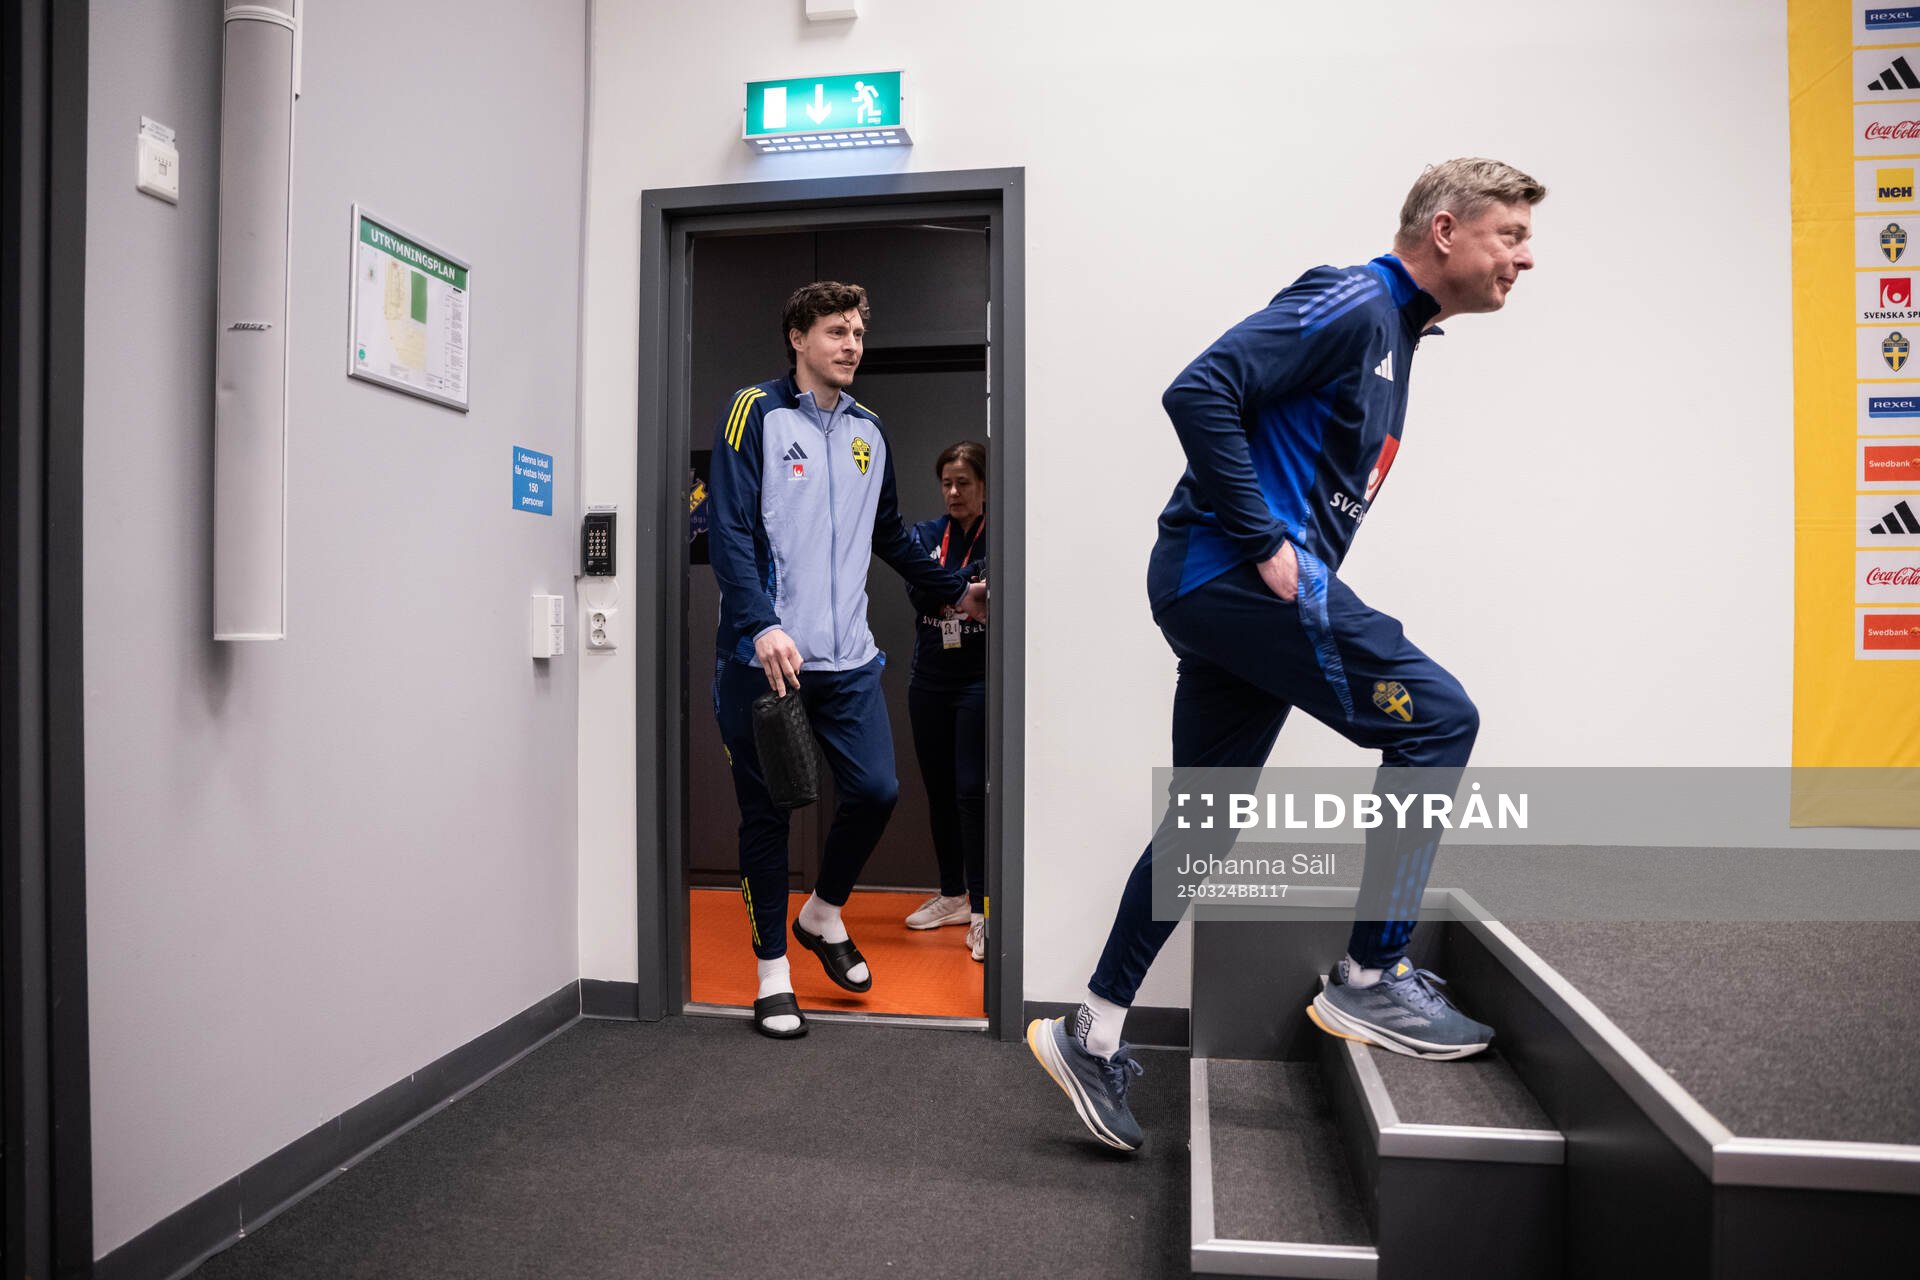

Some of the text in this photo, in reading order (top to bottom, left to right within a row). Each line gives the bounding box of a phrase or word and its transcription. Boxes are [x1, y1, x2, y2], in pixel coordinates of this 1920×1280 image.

[1865, 121, 1920, 140] Coca-Cola
[371, 229, 456, 280] UTRYMNINGSPLAN
[1864, 311, 1905, 319] SVENSKA
[521, 453, 537, 465] denna
[537, 457, 549, 468] lokal
[1869, 460, 1910, 468] Swedbank
[514, 464, 552, 483] får vistas högst
[529, 482, 539, 493] 150
[522, 496, 545, 507] personer
[1866, 567, 1920, 585] Coca-Cola
[1868, 628, 1908, 636] Swedbank
